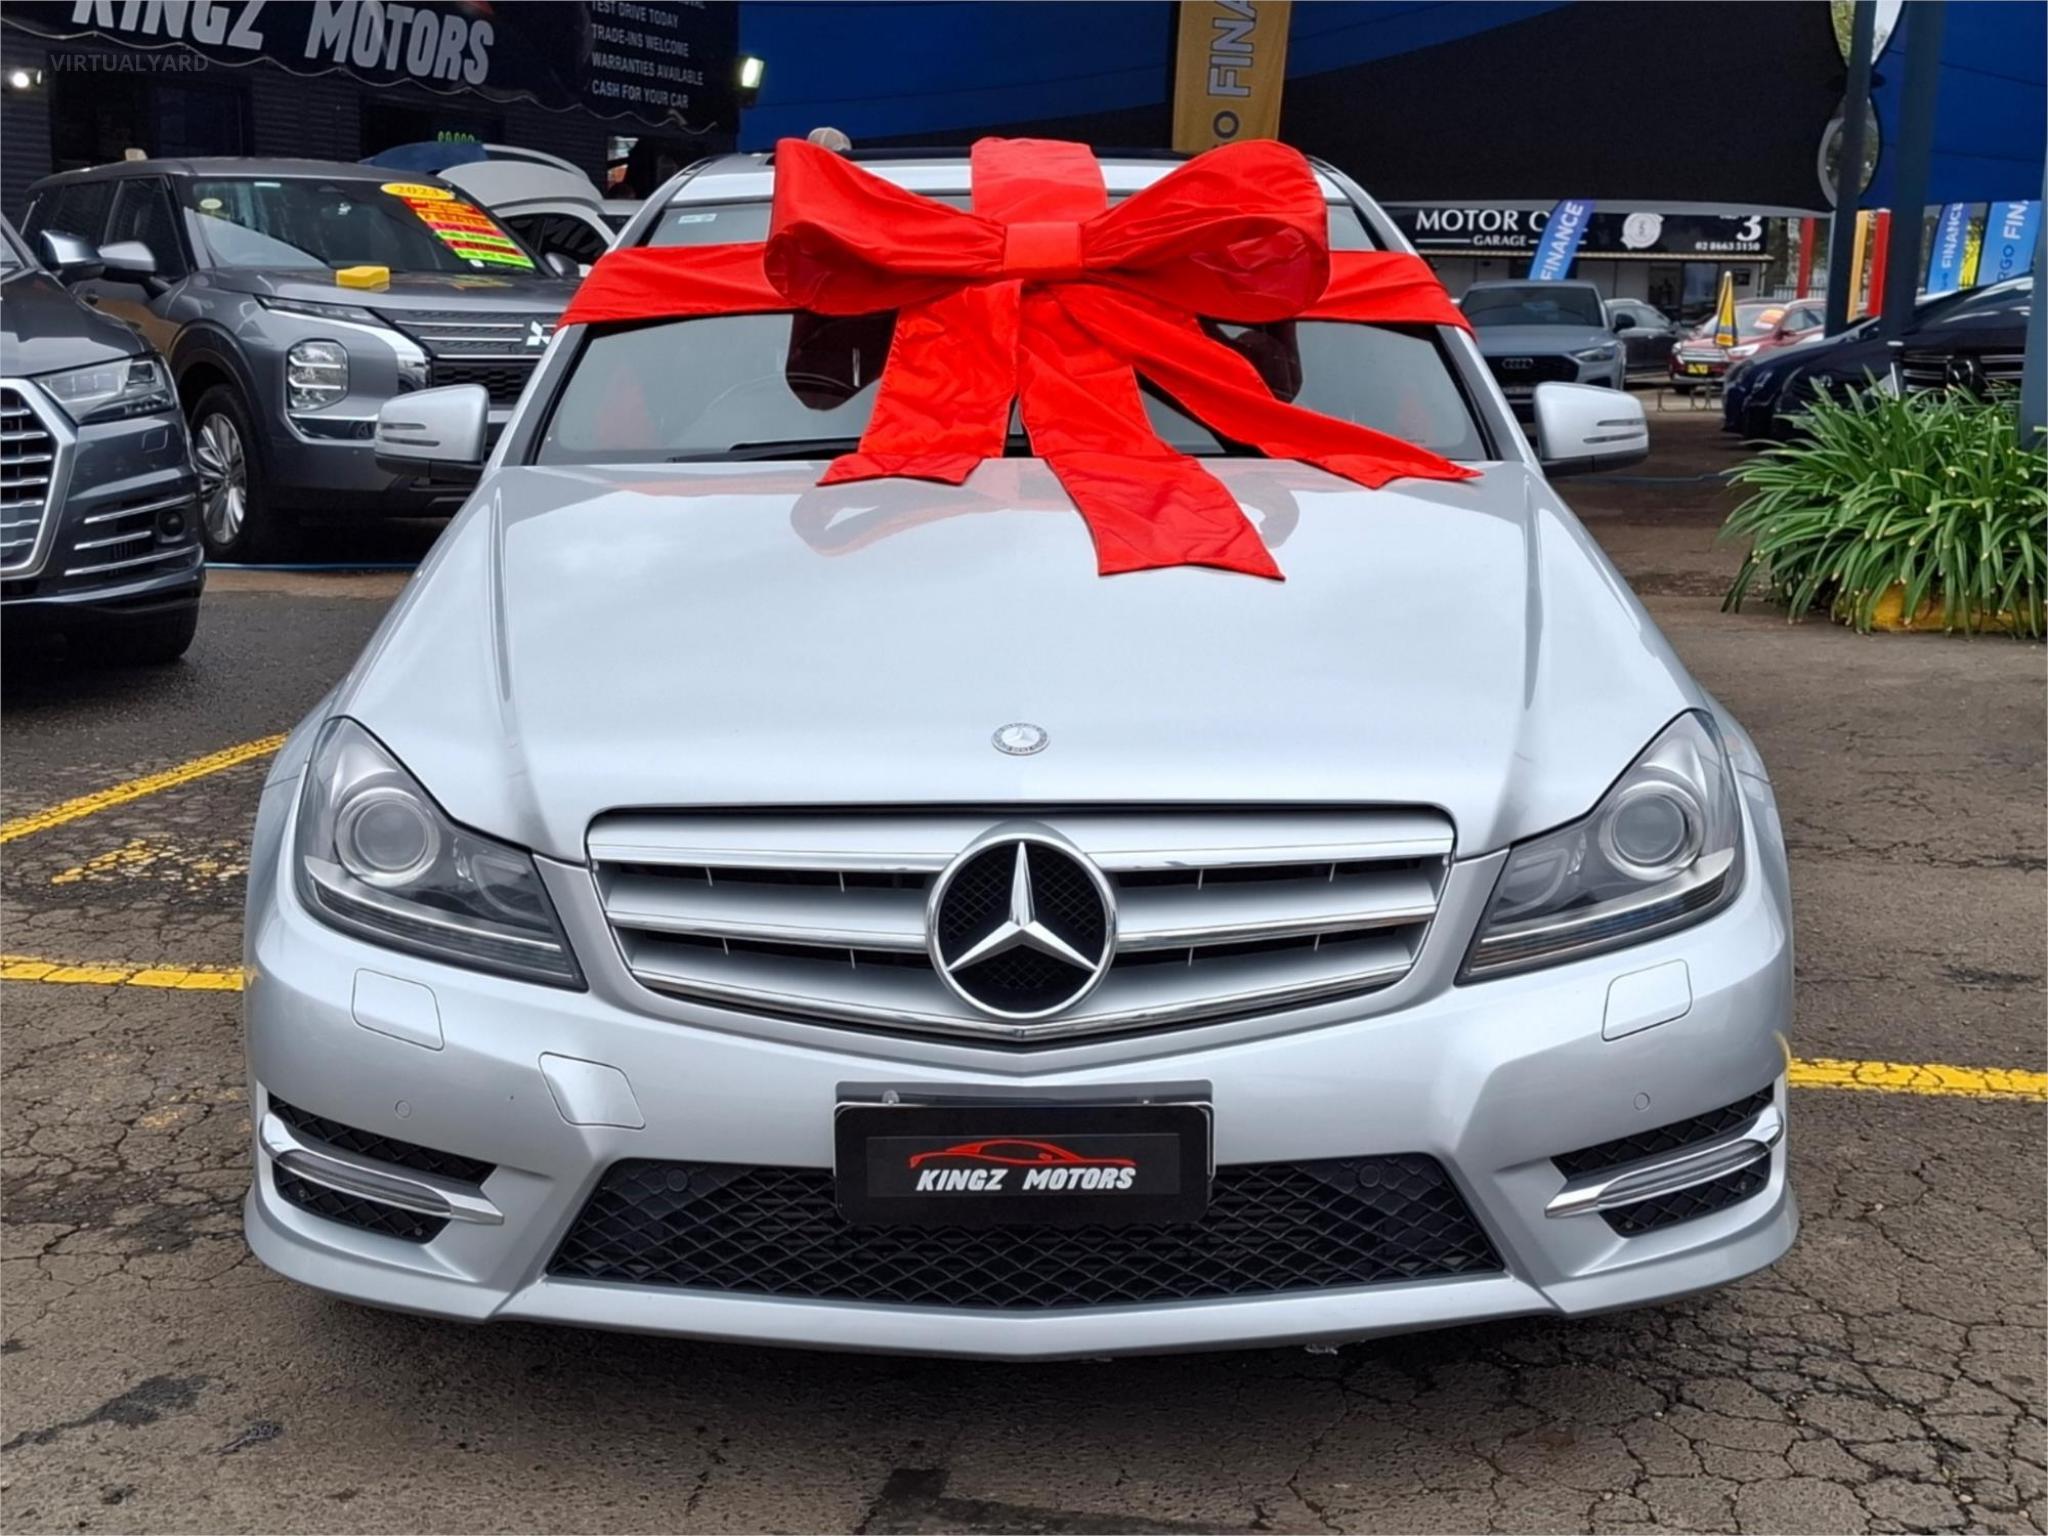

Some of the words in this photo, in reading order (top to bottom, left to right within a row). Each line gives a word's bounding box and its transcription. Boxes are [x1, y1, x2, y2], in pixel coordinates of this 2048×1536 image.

[592, 1, 616, 14] TEST
[619, 3, 647, 21] DRIVE
[649, 9, 679, 28] TODAY
[304, 1, 494, 85] MOTORS
[591, 23, 643, 48] TRADE-INS
[645, 35, 689, 57] WELCOME
[592, 51, 655, 77] WARRANTIES
[656, 65, 704, 86] AVAILABLE
[592, 80, 620, 97] CASH
[622, 85, 641, 101] FOR
[643, 88, 669, 106] YOUR
[670, 93, 689, 108] CAR
[1416, 209, 1519, 232] MOTOR
[2003, 200, 2029, 240] FIN
[1473, 235, 1527, 247] GARAGE
[1540, 201, 1584, 280] FINANCE
[916, 1168, 1008, 1191] KINGZ
[1022, 1167, 1137, 1190] MOTORS
